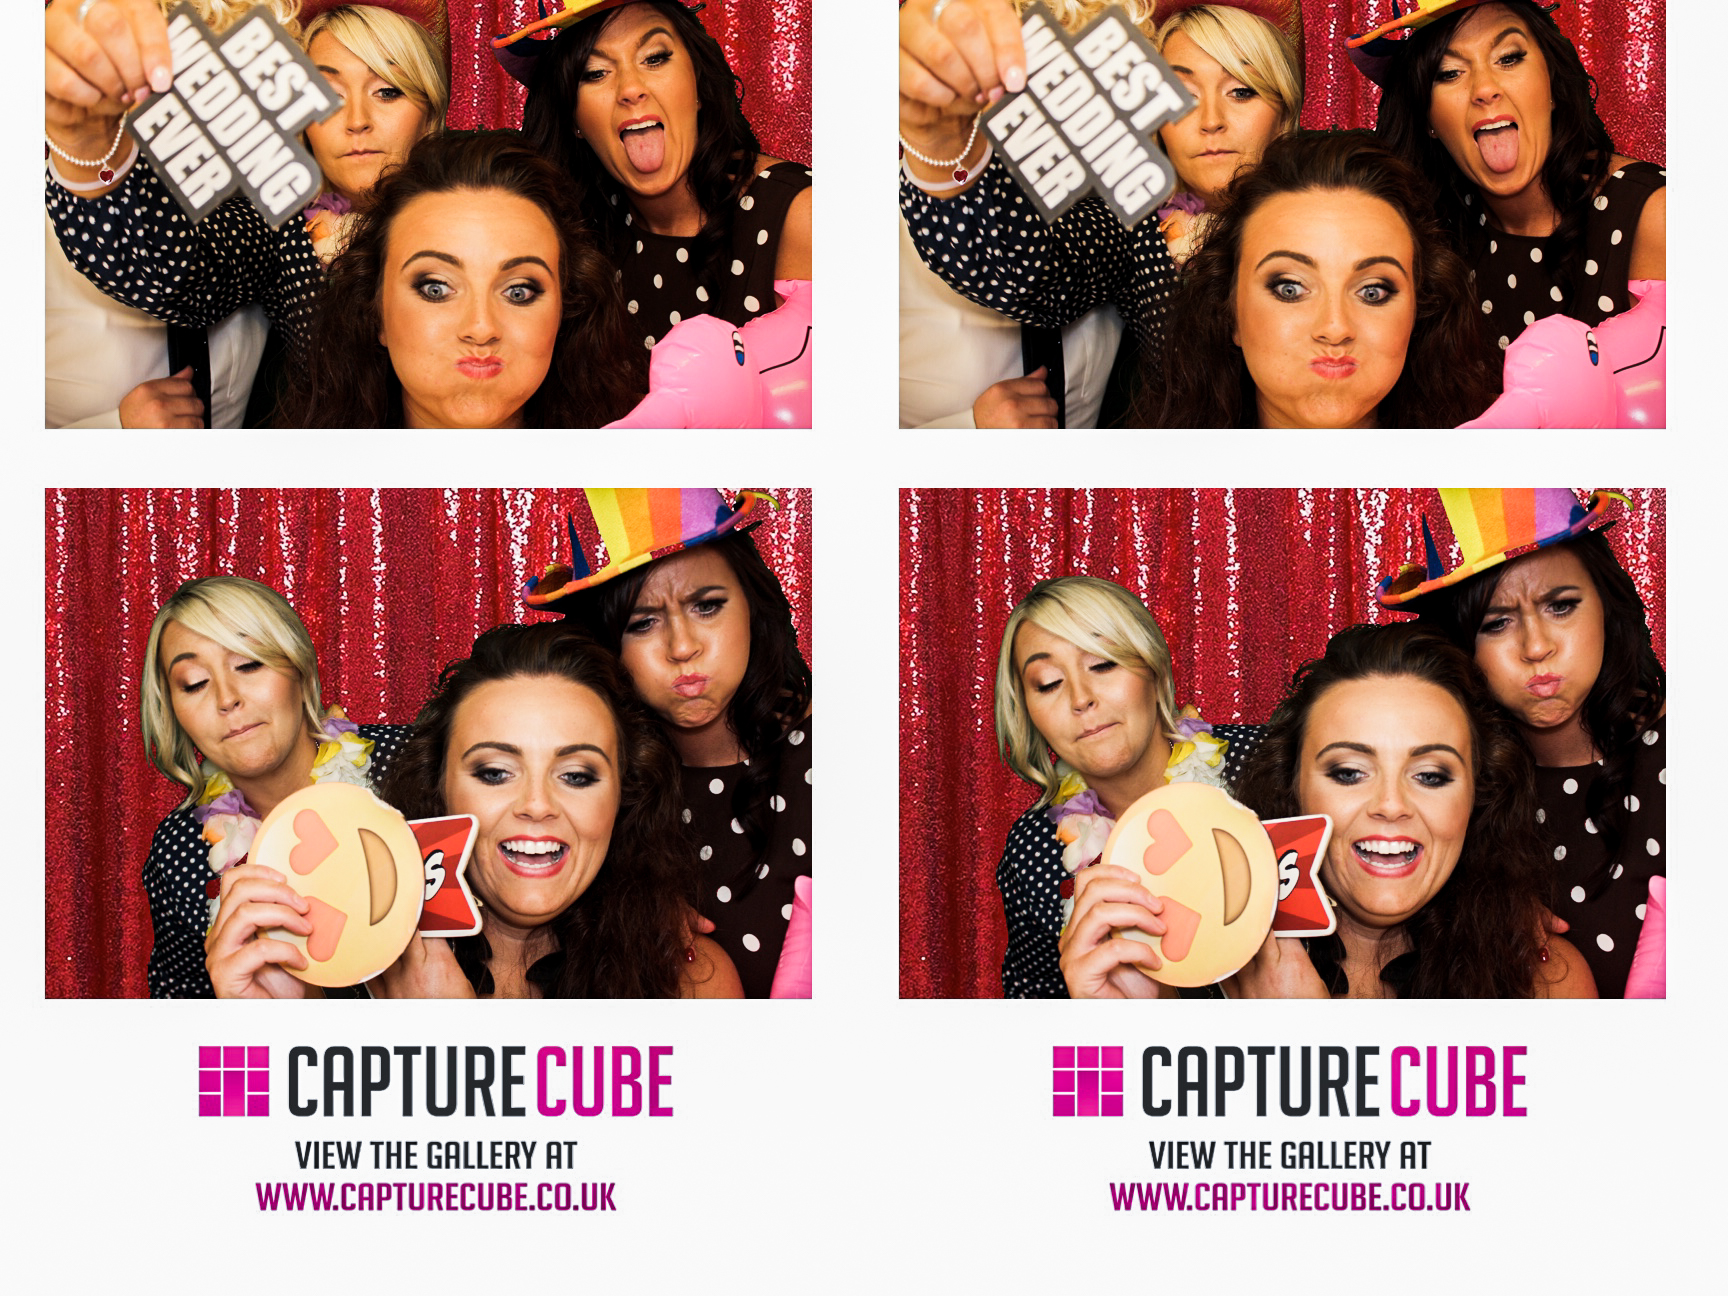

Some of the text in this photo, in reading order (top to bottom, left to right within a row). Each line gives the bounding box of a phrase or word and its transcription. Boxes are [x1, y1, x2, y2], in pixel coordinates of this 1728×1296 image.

[167, 13, 312, 215] WEDDING
[219, 15, 330, 131] BEST
[1021, 13, 1166, 215] WEDDING
[1073, 15, 1184, 131] BEST
[132, 92, 232, 210] EVER
[986, 92, 1086, 210] EVER
